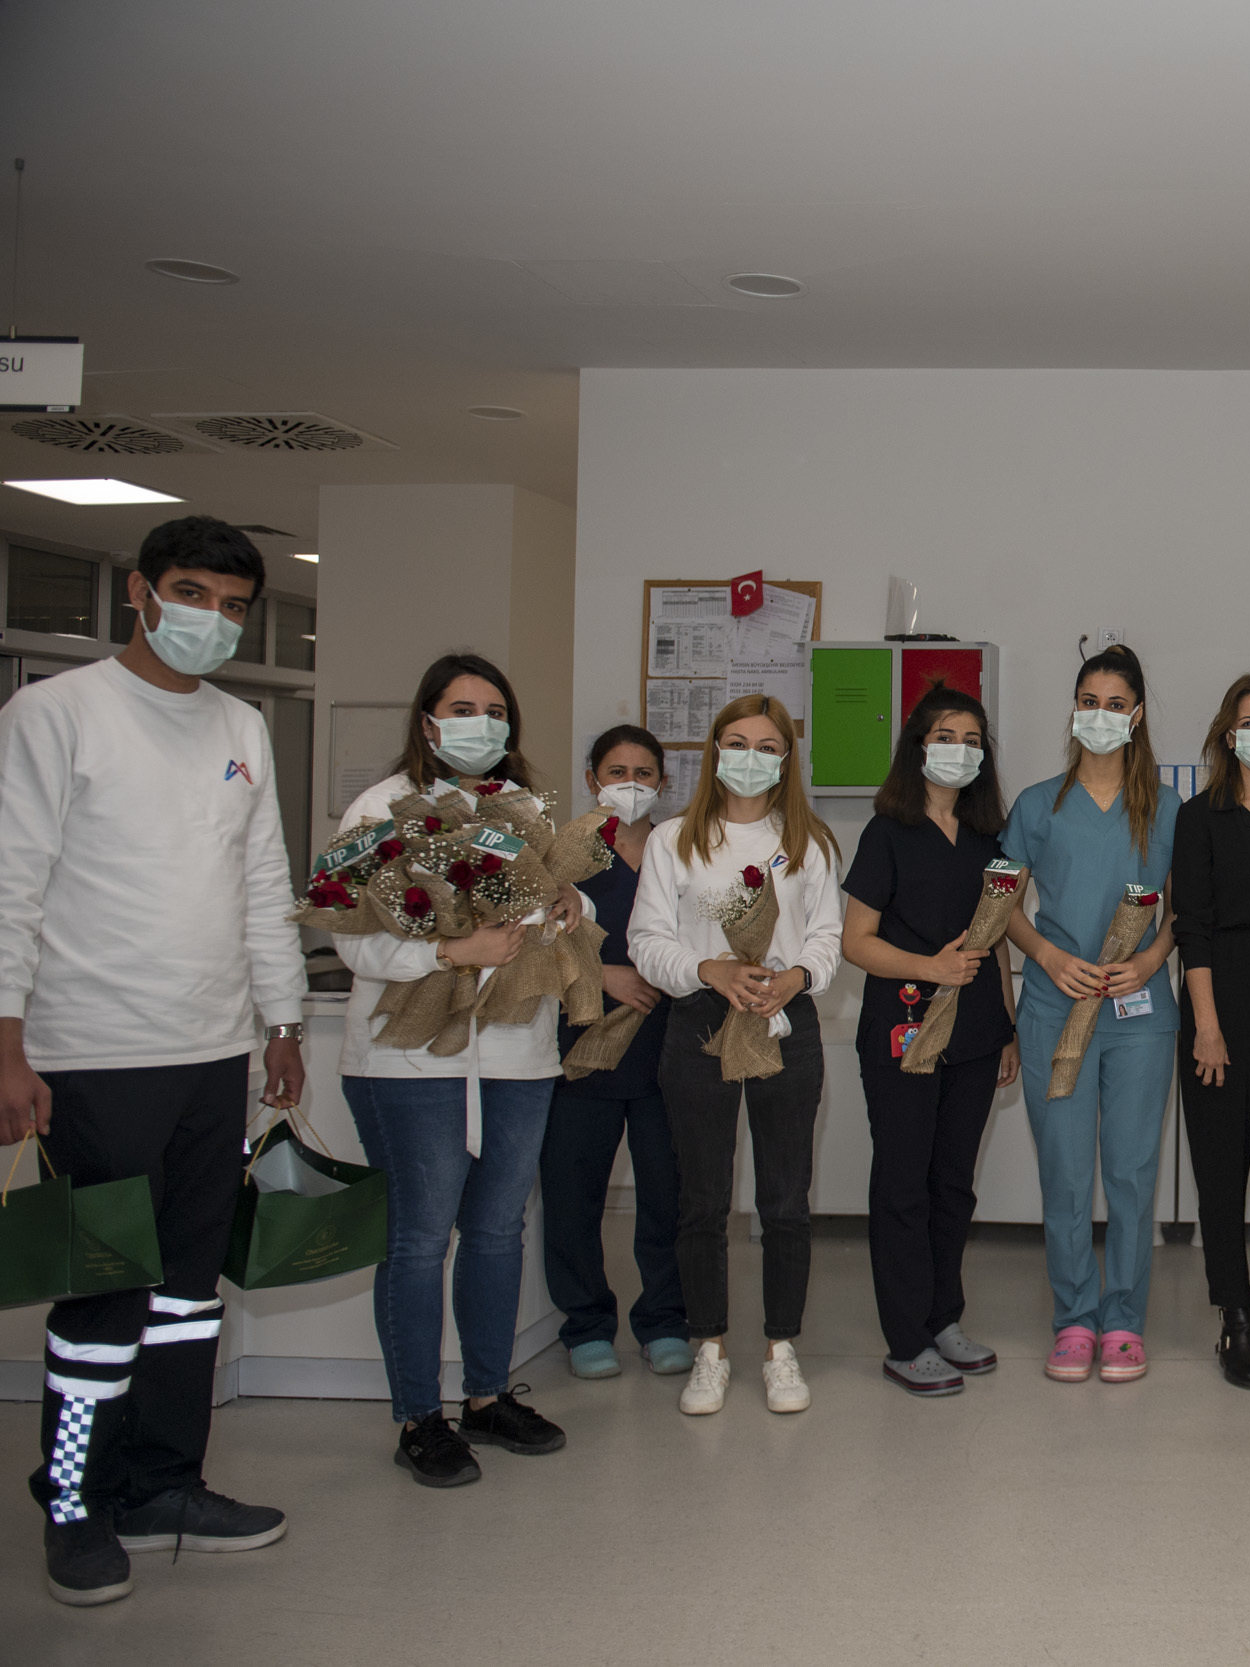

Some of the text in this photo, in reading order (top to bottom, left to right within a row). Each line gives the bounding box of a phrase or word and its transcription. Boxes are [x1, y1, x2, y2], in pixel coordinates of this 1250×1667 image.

[354, 832, 377, 852] TIP
[480, 828, 505, 847] TIP
[324, 848, 347, 868] TIP
[990, 859, 1009, 869] TIP
[1126, 883, 1144, 893] TIP
